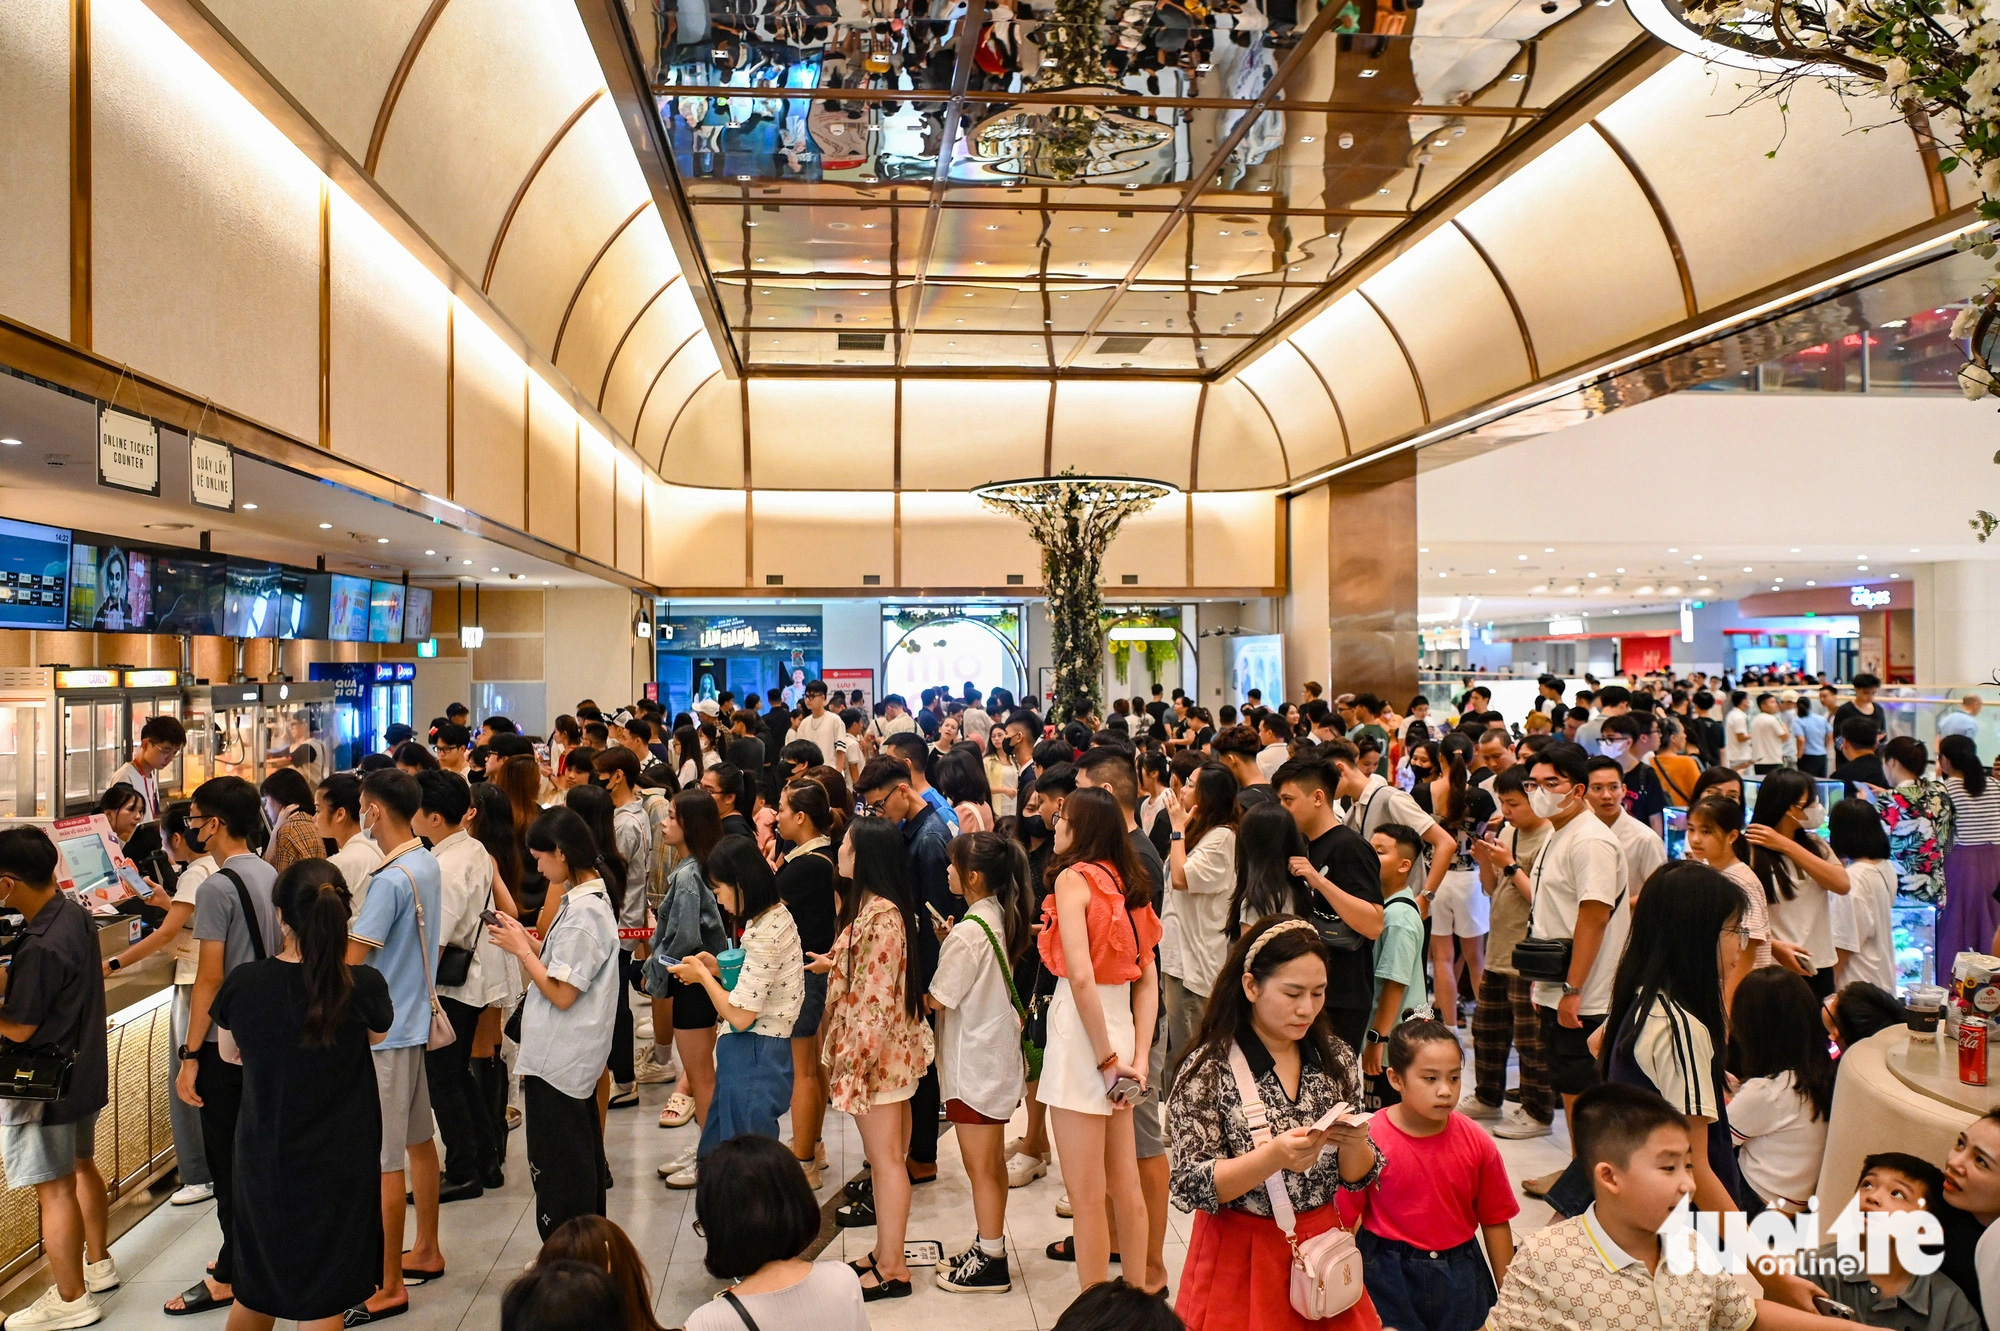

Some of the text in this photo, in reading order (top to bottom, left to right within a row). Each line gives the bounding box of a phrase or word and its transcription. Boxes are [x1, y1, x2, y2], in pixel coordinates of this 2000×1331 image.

[103, 433, 154, 457] ONLINE TICKET
[113, 451, 144, 469] COUNTER
[196, 473, 228, 493] VÉ ONLINE
[1960, 1029, 1981, 1049] ola
